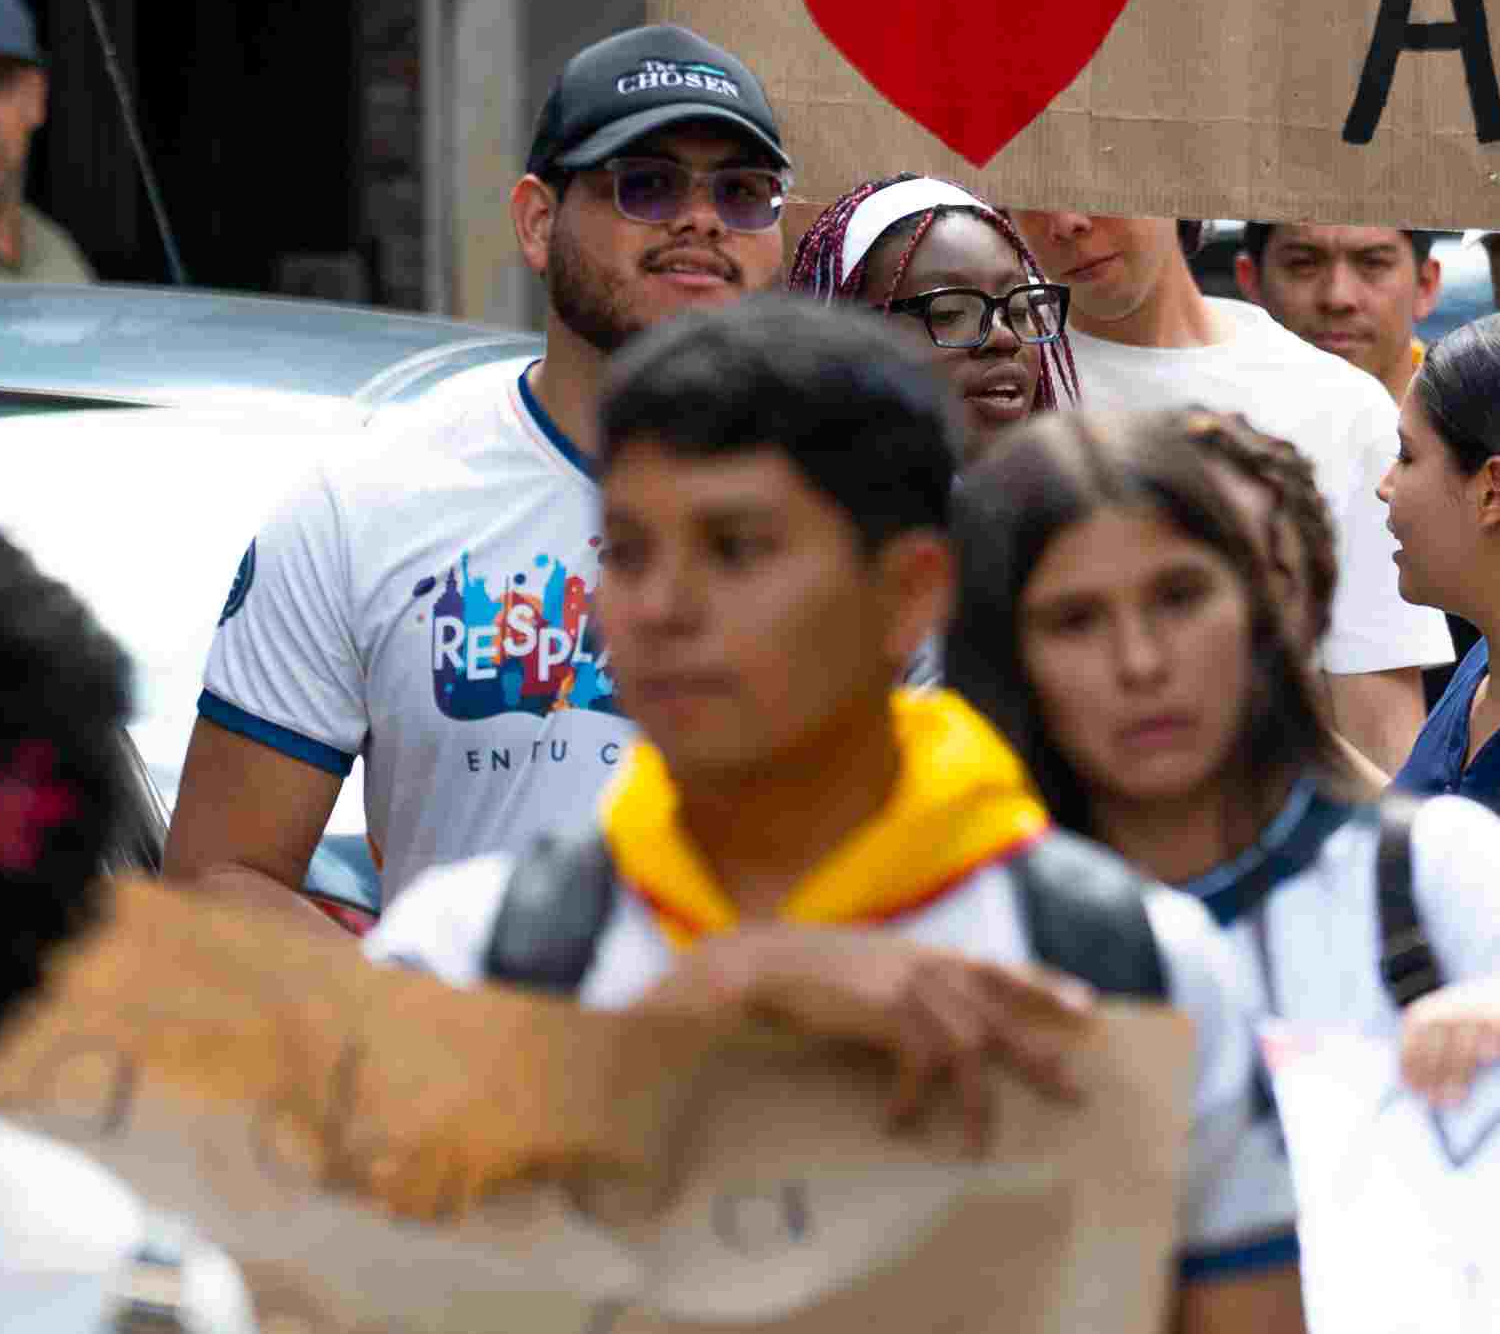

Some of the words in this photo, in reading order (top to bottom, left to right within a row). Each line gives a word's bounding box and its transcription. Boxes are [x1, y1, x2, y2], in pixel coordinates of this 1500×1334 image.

[616, 71, 740, 100] CHOSEN
[433, 602, 610, 683] RESPL
[467, 748, 511, 772] EN
